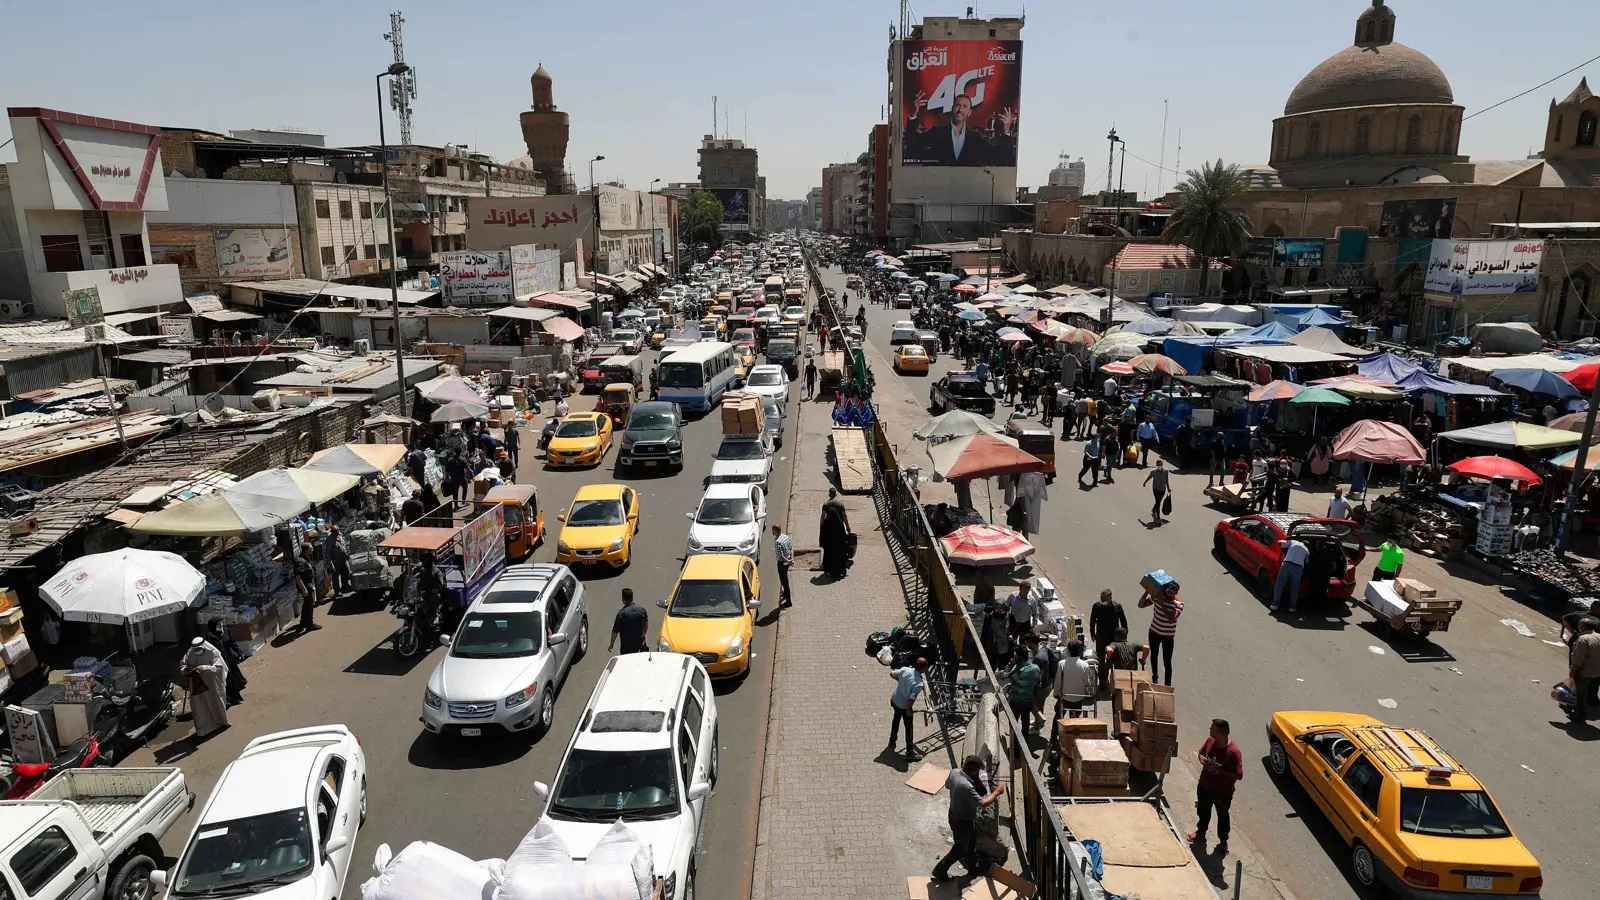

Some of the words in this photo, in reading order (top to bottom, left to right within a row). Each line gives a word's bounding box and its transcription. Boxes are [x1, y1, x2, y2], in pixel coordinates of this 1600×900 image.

[906, 51, 948, 71] العراق
[976, 64, 996, 78] LTE
[927, 69, 985, 113] 4G
[484, 208, 536, 228] إعلانك
[464, 254, 488, 266] محلات
[1468, 259, 1510, 278] السوداني
[1513, 261, 1538, 273] حيدر
[136, 588, 167, 607] PINE
